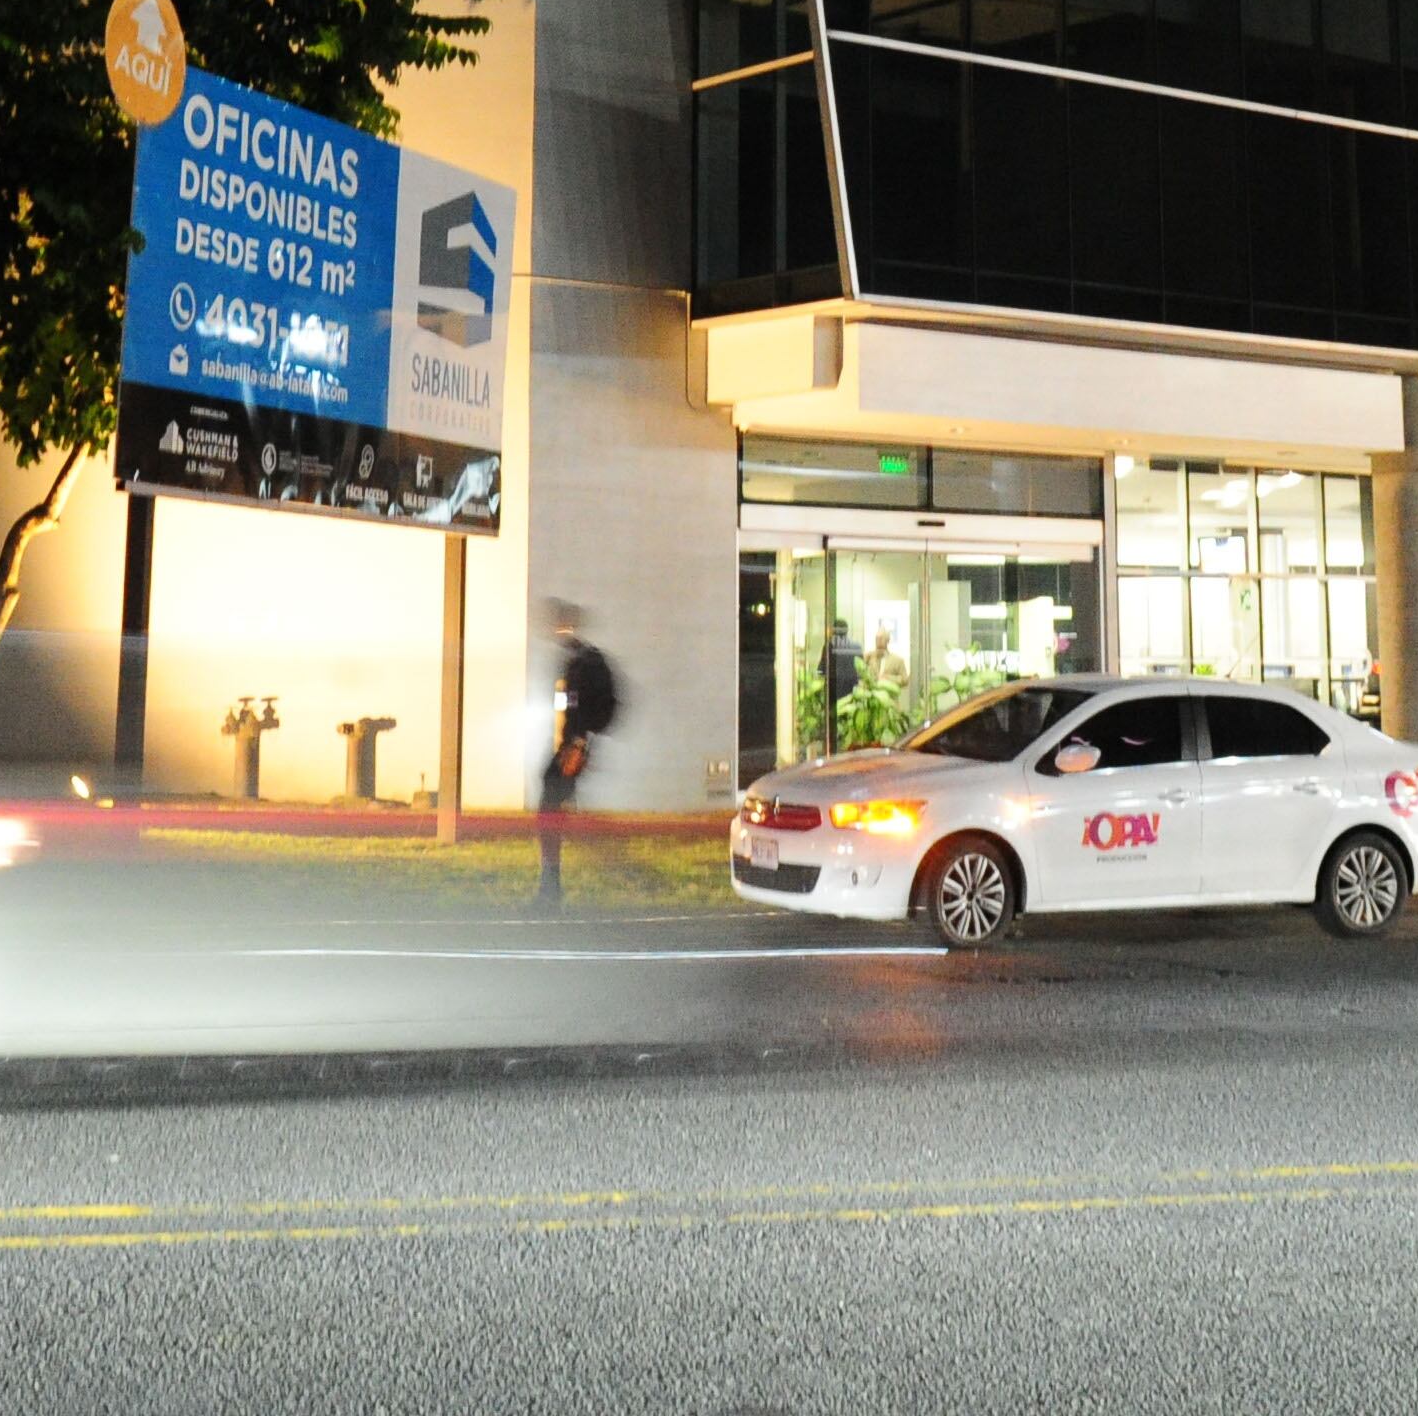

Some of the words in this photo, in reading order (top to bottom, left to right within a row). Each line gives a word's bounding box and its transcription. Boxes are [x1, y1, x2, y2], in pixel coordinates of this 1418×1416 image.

[183, 93, 359, 199] OFICINAS
[179, 158, 358, 249] DISPONIBLES
[175, 217, 261, 274] DESDE
[267, 237, 314, 288] 612
[201, 354, 349, 404] sabanilla@ab-lata.com
[410, 351, 491, 409] SABANILLA
[186, 427, 232, 447] CUSHMAN
[186, 443, 239, 463] WAKEFIELD
